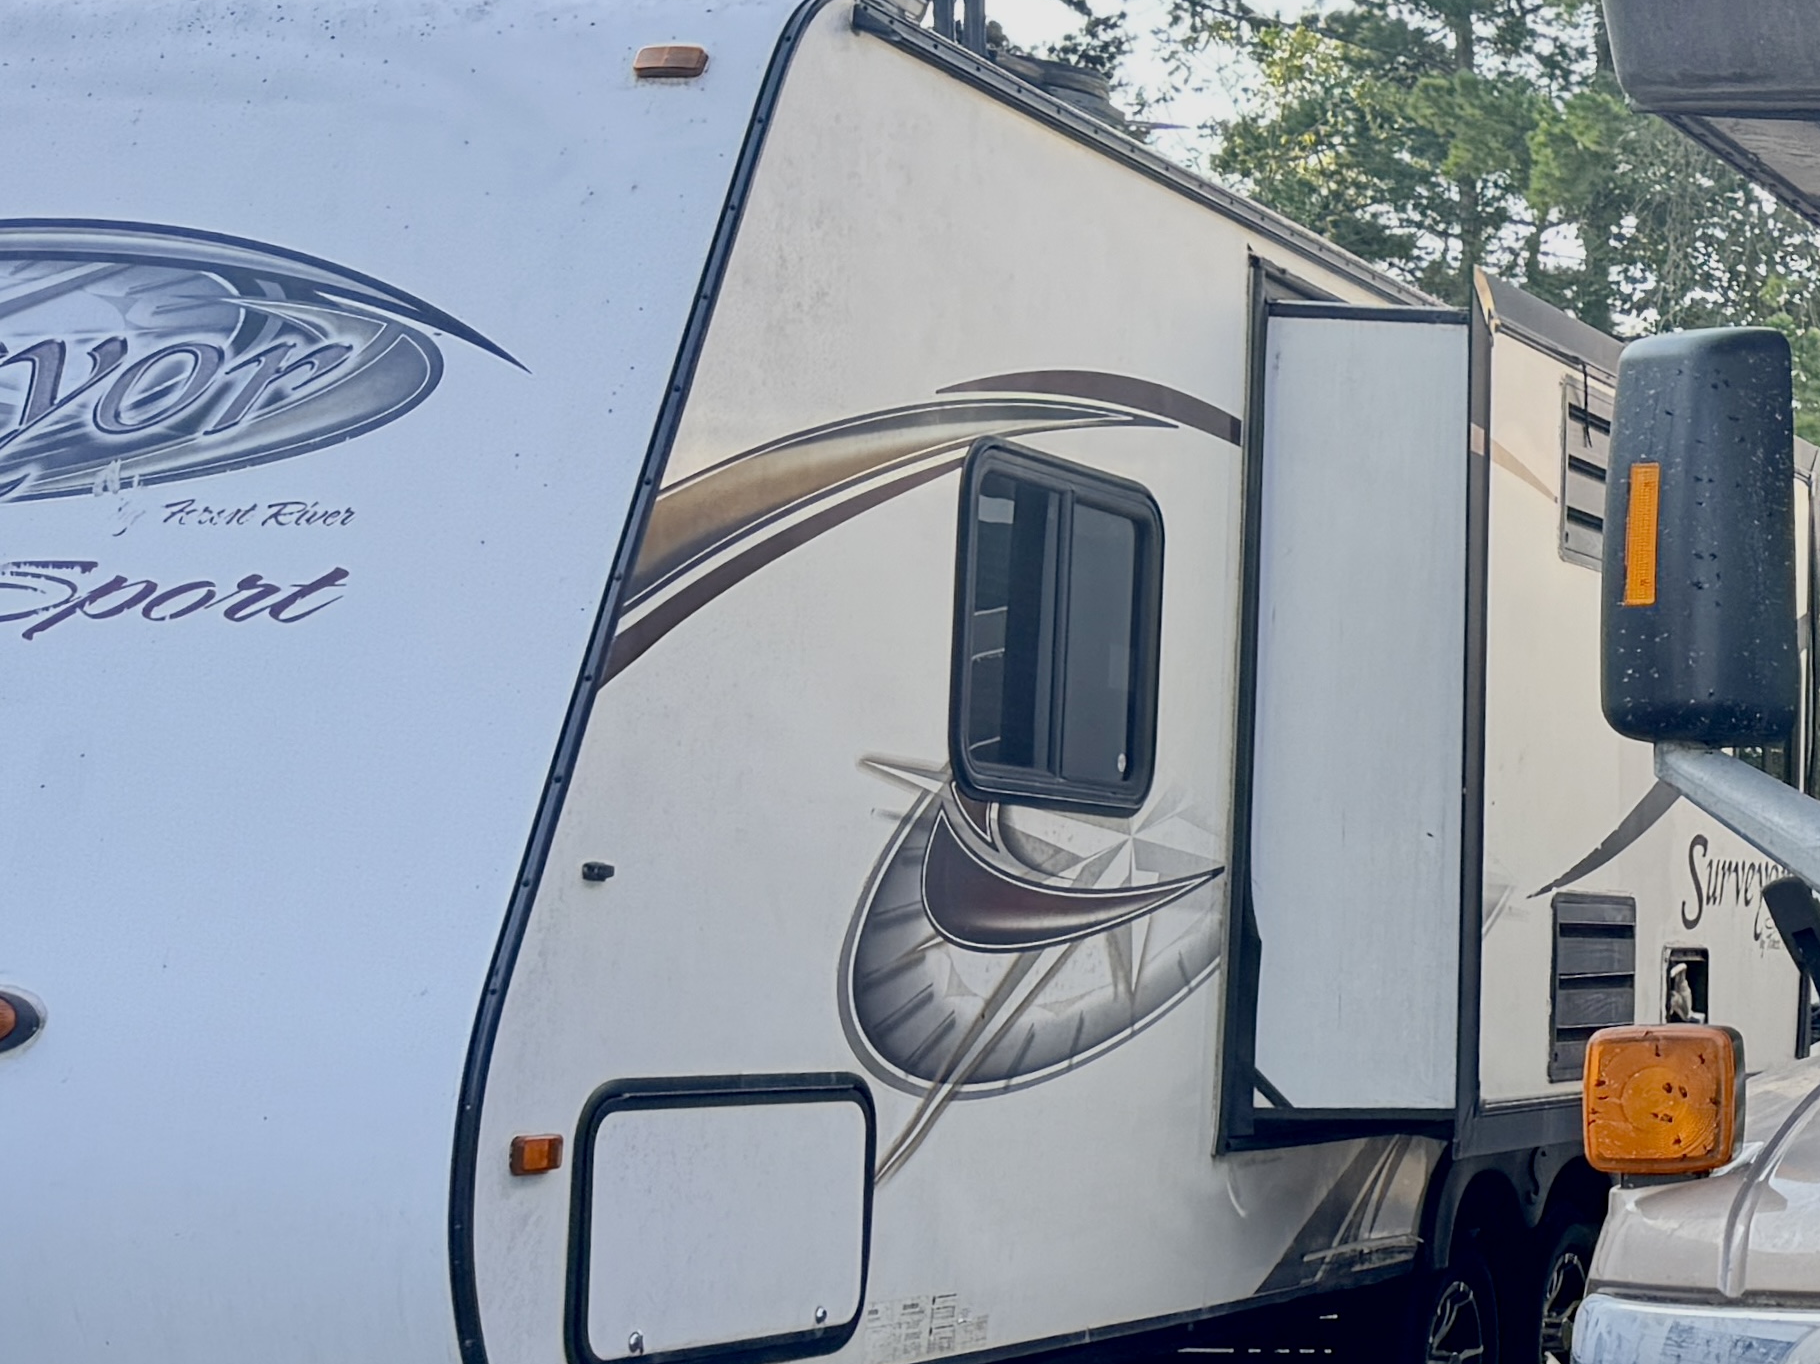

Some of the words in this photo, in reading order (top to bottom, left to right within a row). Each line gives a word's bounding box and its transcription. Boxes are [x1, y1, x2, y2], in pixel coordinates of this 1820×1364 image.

[0, 334, 354, 447] yor
[261, 501, 356, 527] River
[0, 560, 349, 641] Sport
